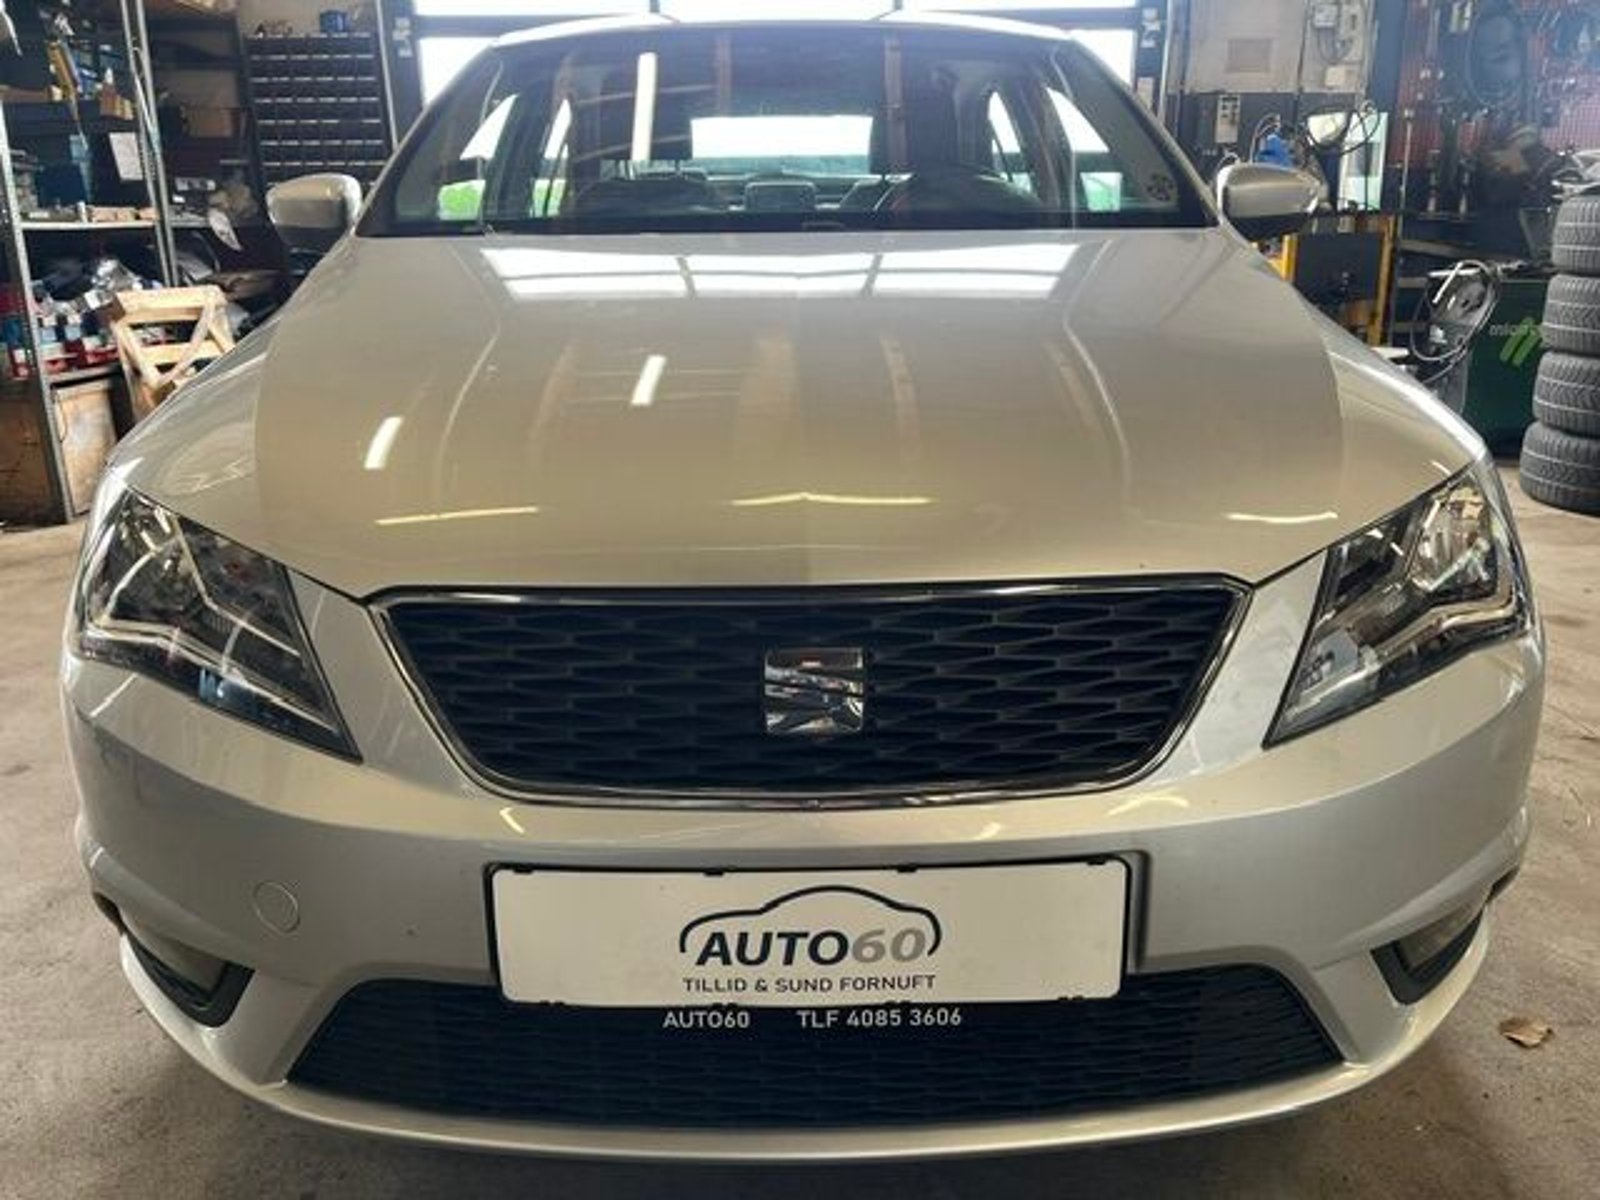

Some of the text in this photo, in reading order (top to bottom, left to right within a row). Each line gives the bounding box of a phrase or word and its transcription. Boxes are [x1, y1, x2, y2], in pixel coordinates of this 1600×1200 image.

[695, 927, 926, 966] AUTO60
[682, 974, 937, 993] TILLID & SUND FORNUFT
[662, 1010, 750, 1028] AUTO60
[796, 1007, 962, 1028] TLF 4085 3606
